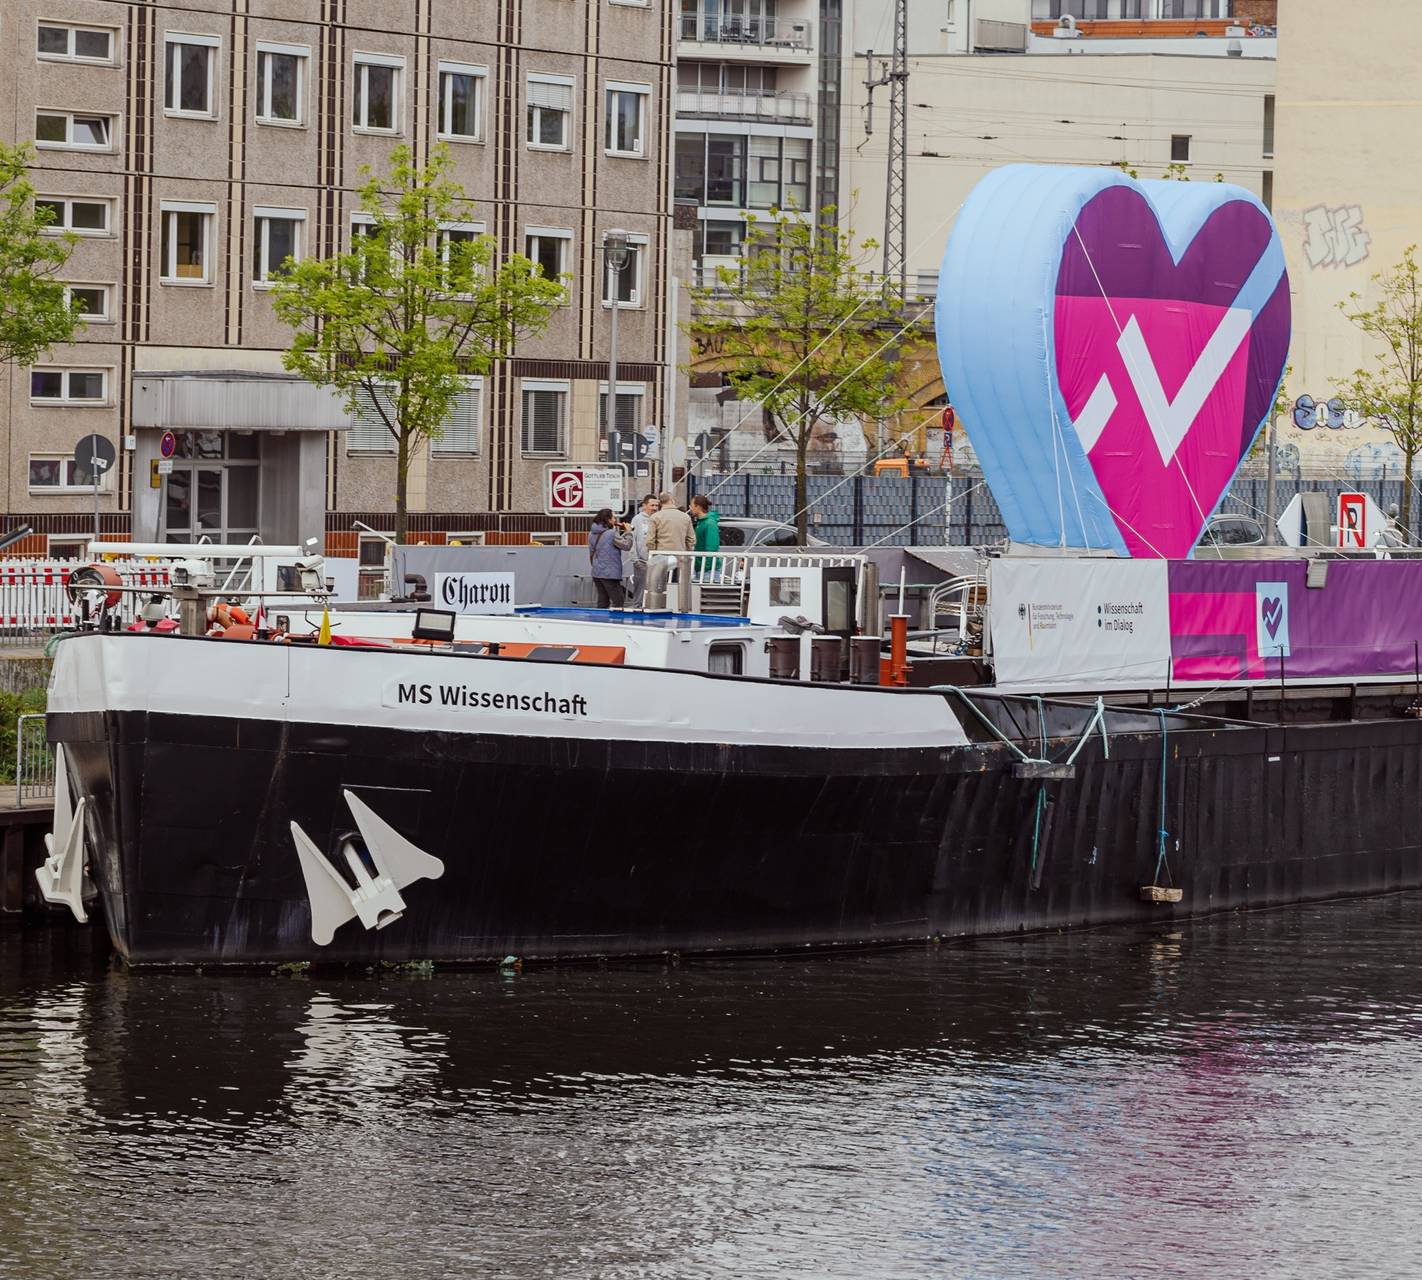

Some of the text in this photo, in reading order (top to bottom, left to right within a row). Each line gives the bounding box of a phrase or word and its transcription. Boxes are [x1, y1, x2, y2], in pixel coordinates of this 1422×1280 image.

[442, 575, 511, 612] Charon
[1103, 601, 1144, 615] Wissenschaft
[1104, 618, 1134, 634] im Dialog
[398, 683, 587, 716] MS Wissenschaft
